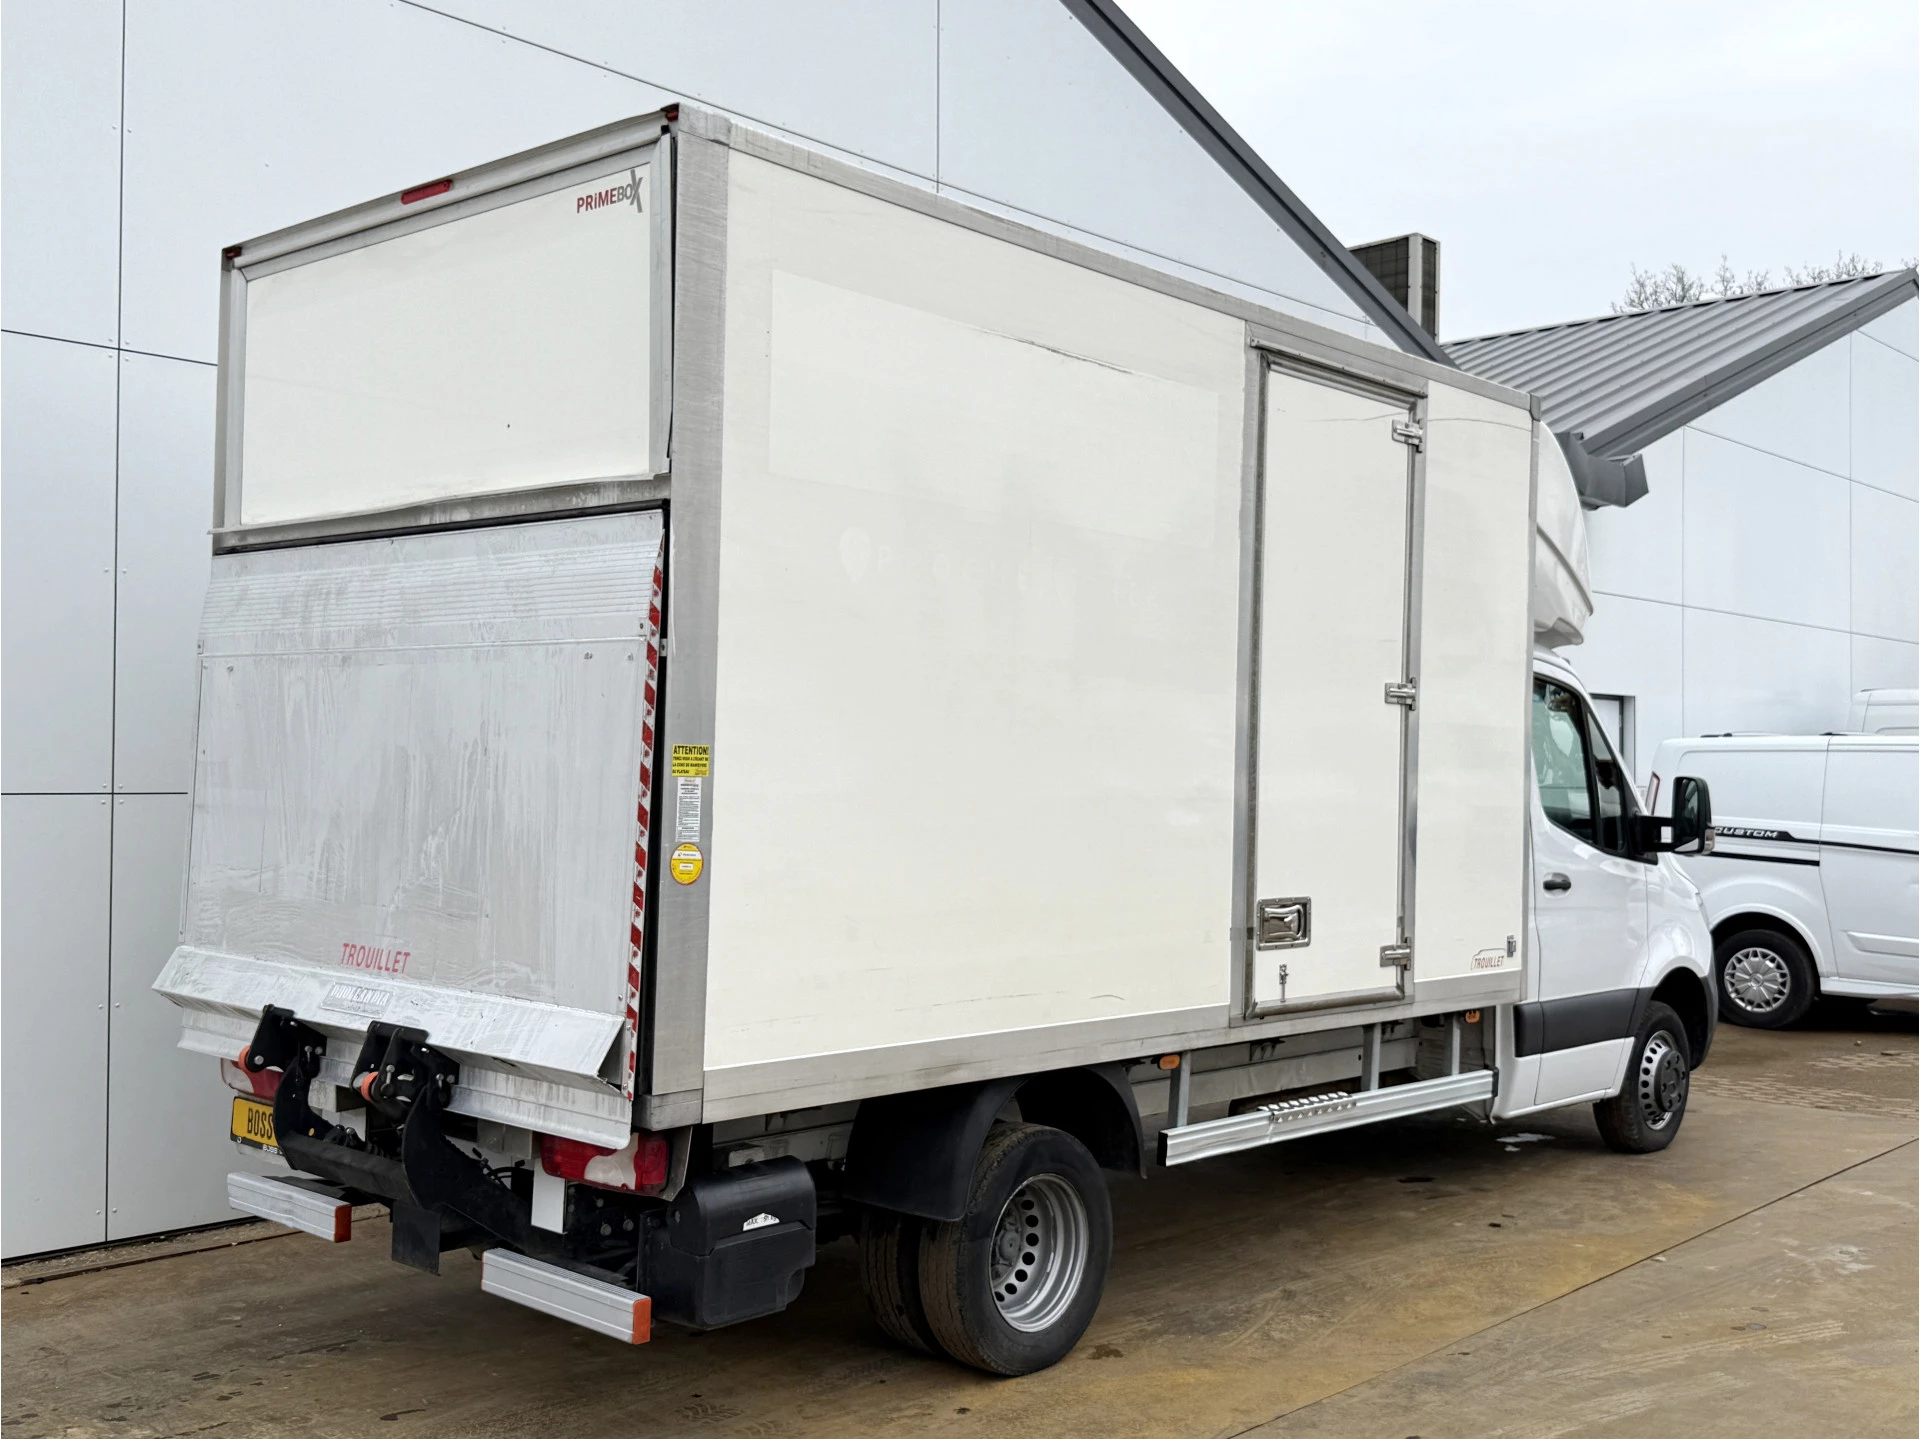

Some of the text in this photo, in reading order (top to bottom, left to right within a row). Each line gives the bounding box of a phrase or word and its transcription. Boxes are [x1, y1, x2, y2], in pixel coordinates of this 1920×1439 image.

[1715, 826, 1778, 838] CUSTOM
[341, 943, 411, 974] TROUILLET
[1474, 955, 1505, 969] TROUILLET
[247, 1107, 274, 1140] BOSS
